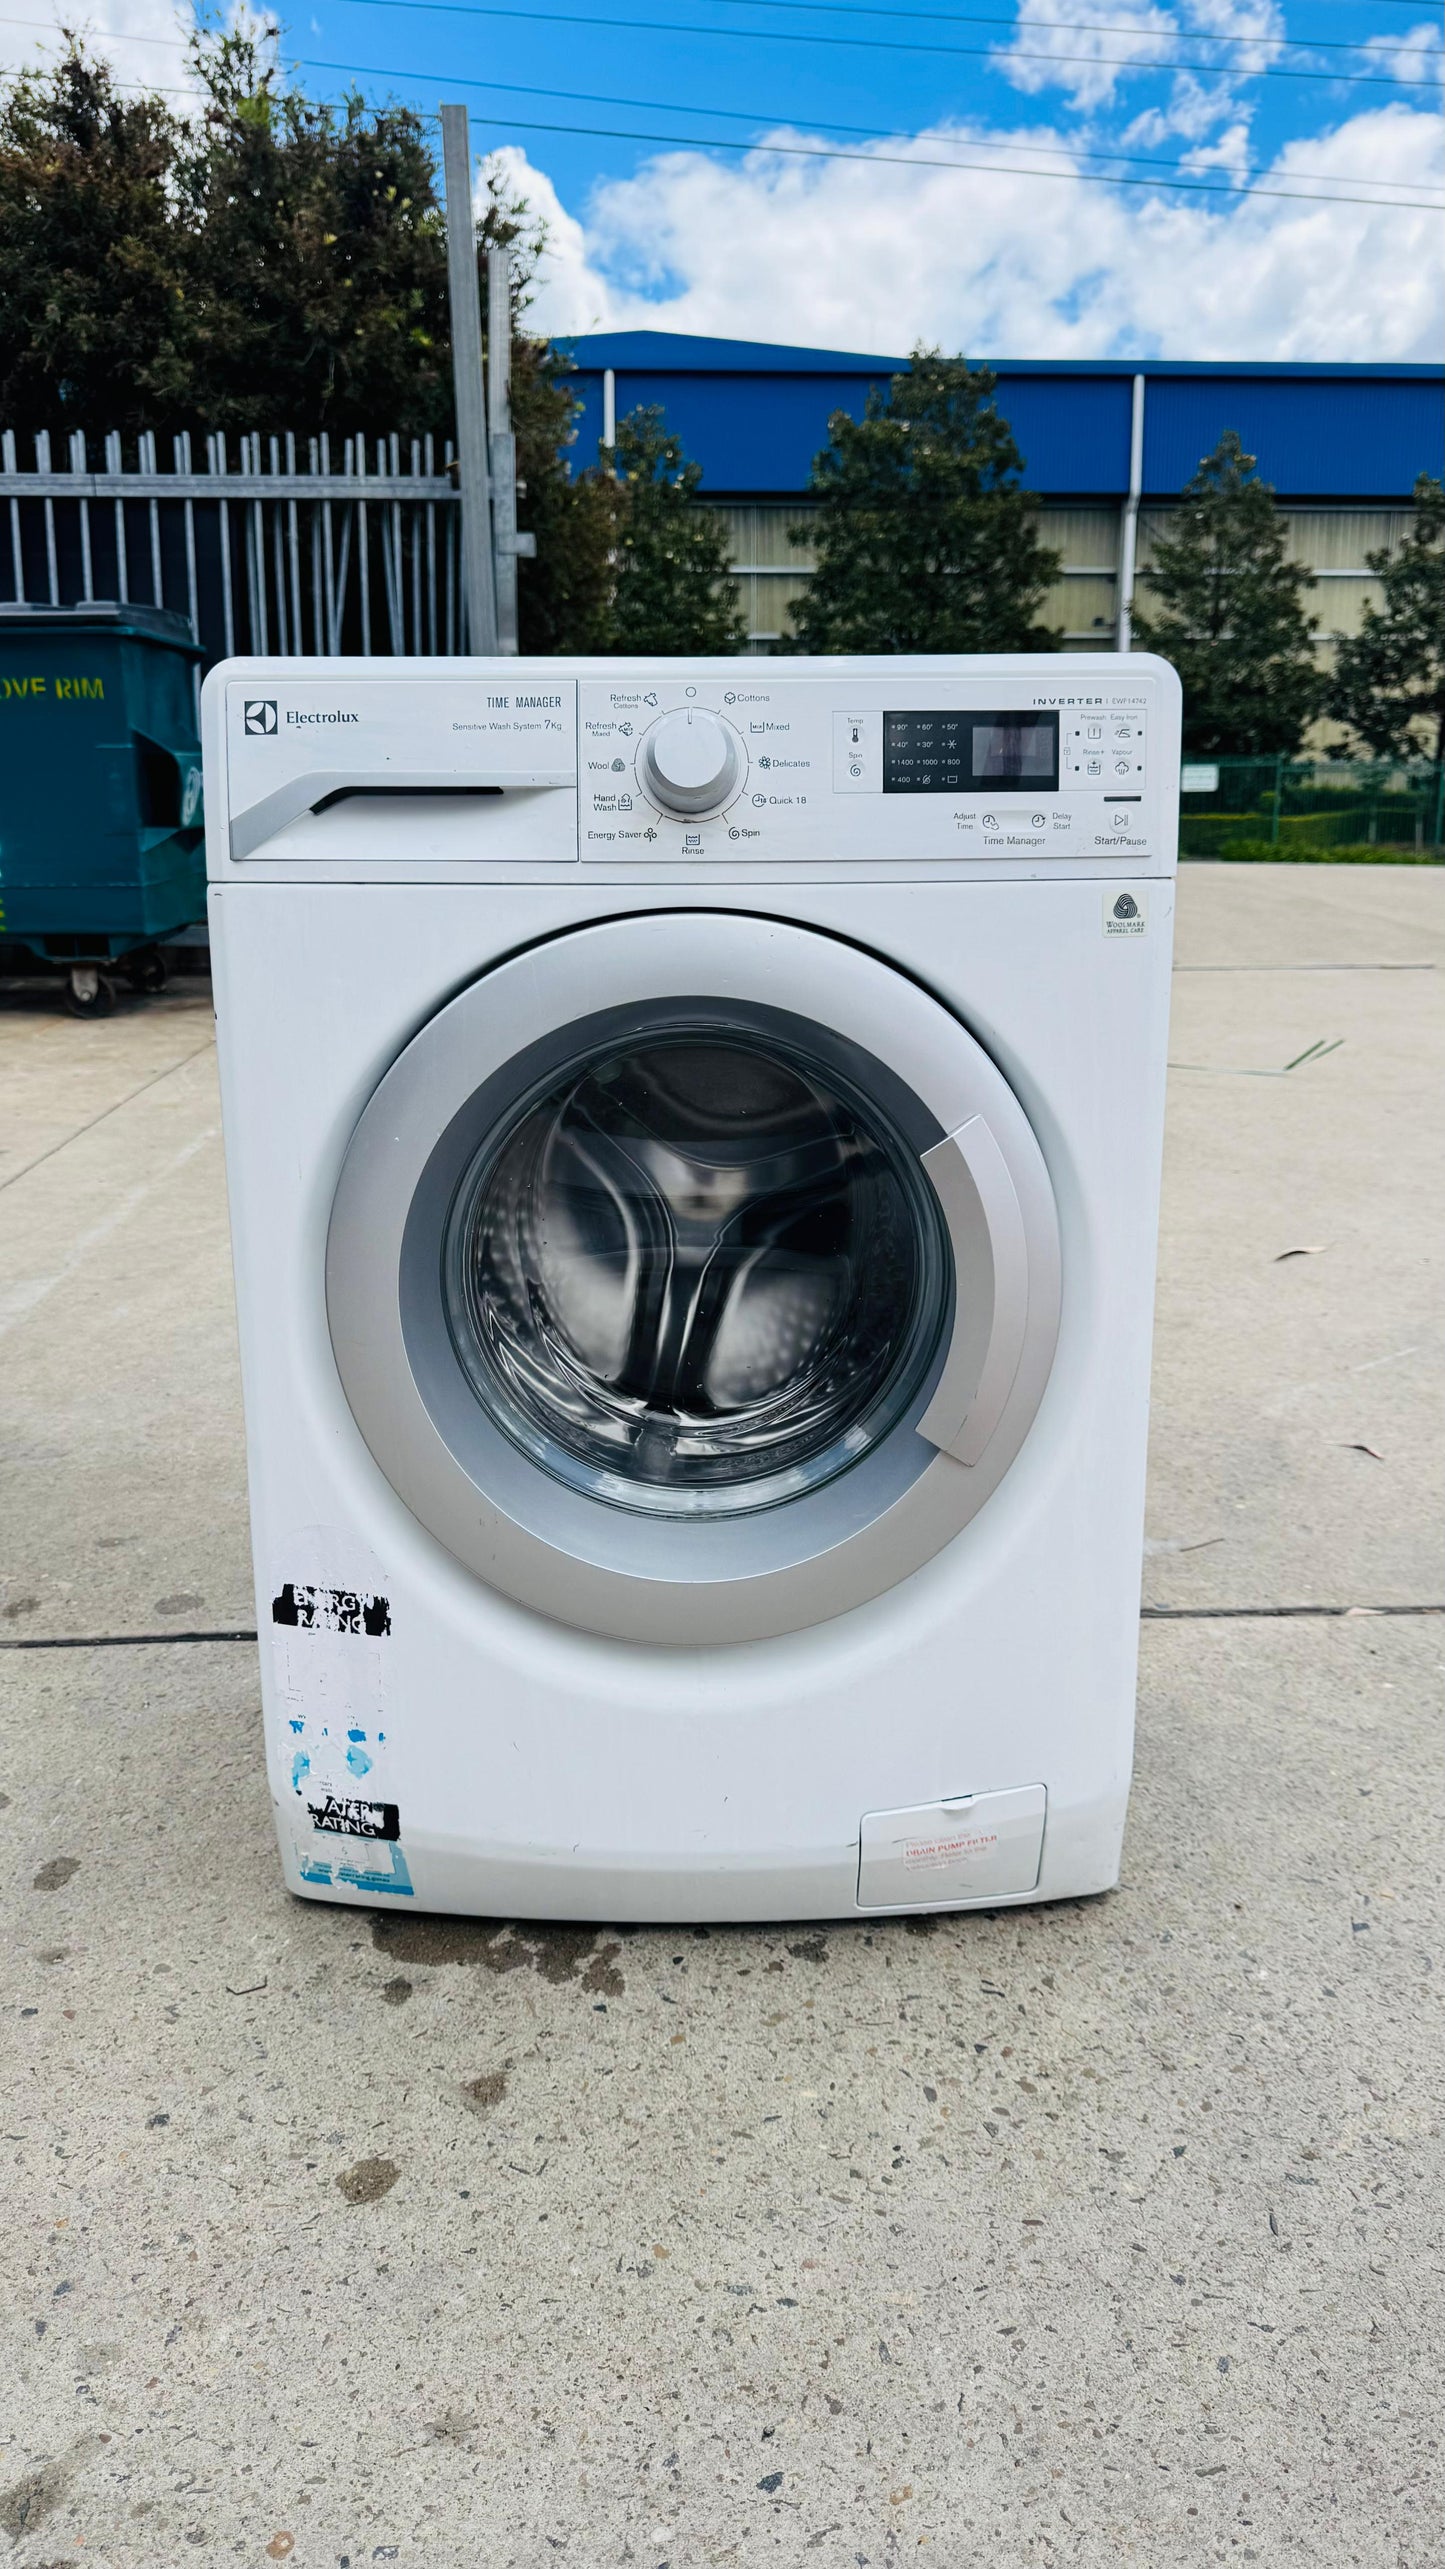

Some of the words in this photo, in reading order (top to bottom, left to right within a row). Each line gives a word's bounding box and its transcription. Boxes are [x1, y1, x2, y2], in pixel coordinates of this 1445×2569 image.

[55, 678, 104, 699] RIM
[486, 697, 509, 708] TIME
[516, 697, 561, 708] MANAGER
[737, 694, 770, 702] Cottons
[286, 711, 359, 724] Electrolux
[452, 722, 486, 730] Sensitive
[489, 722, 511, 730] Wash
[513, 722, 541, 731] System
[544, 720, 562, 731] 7Kg
[593, 794, 616, 802] Hand
[769, 796, 793, 804] Quick
[953, 813, 976, 821] Adjust
[1052, 813, 1072, 821] Delay
[588, 831, 616, 840] Energy
[618, 830, 641, 838] Saver
[742, 829, 760, 838] Spin
[984, 836, 1004, 845] Time
[1007, 836, 1045, 847] Manager
[1094, 836, 1147, 846] Start/Pause
[312, 1814, 375, 1835] RATING
[938, 1841, 965, 1851] PUMP
